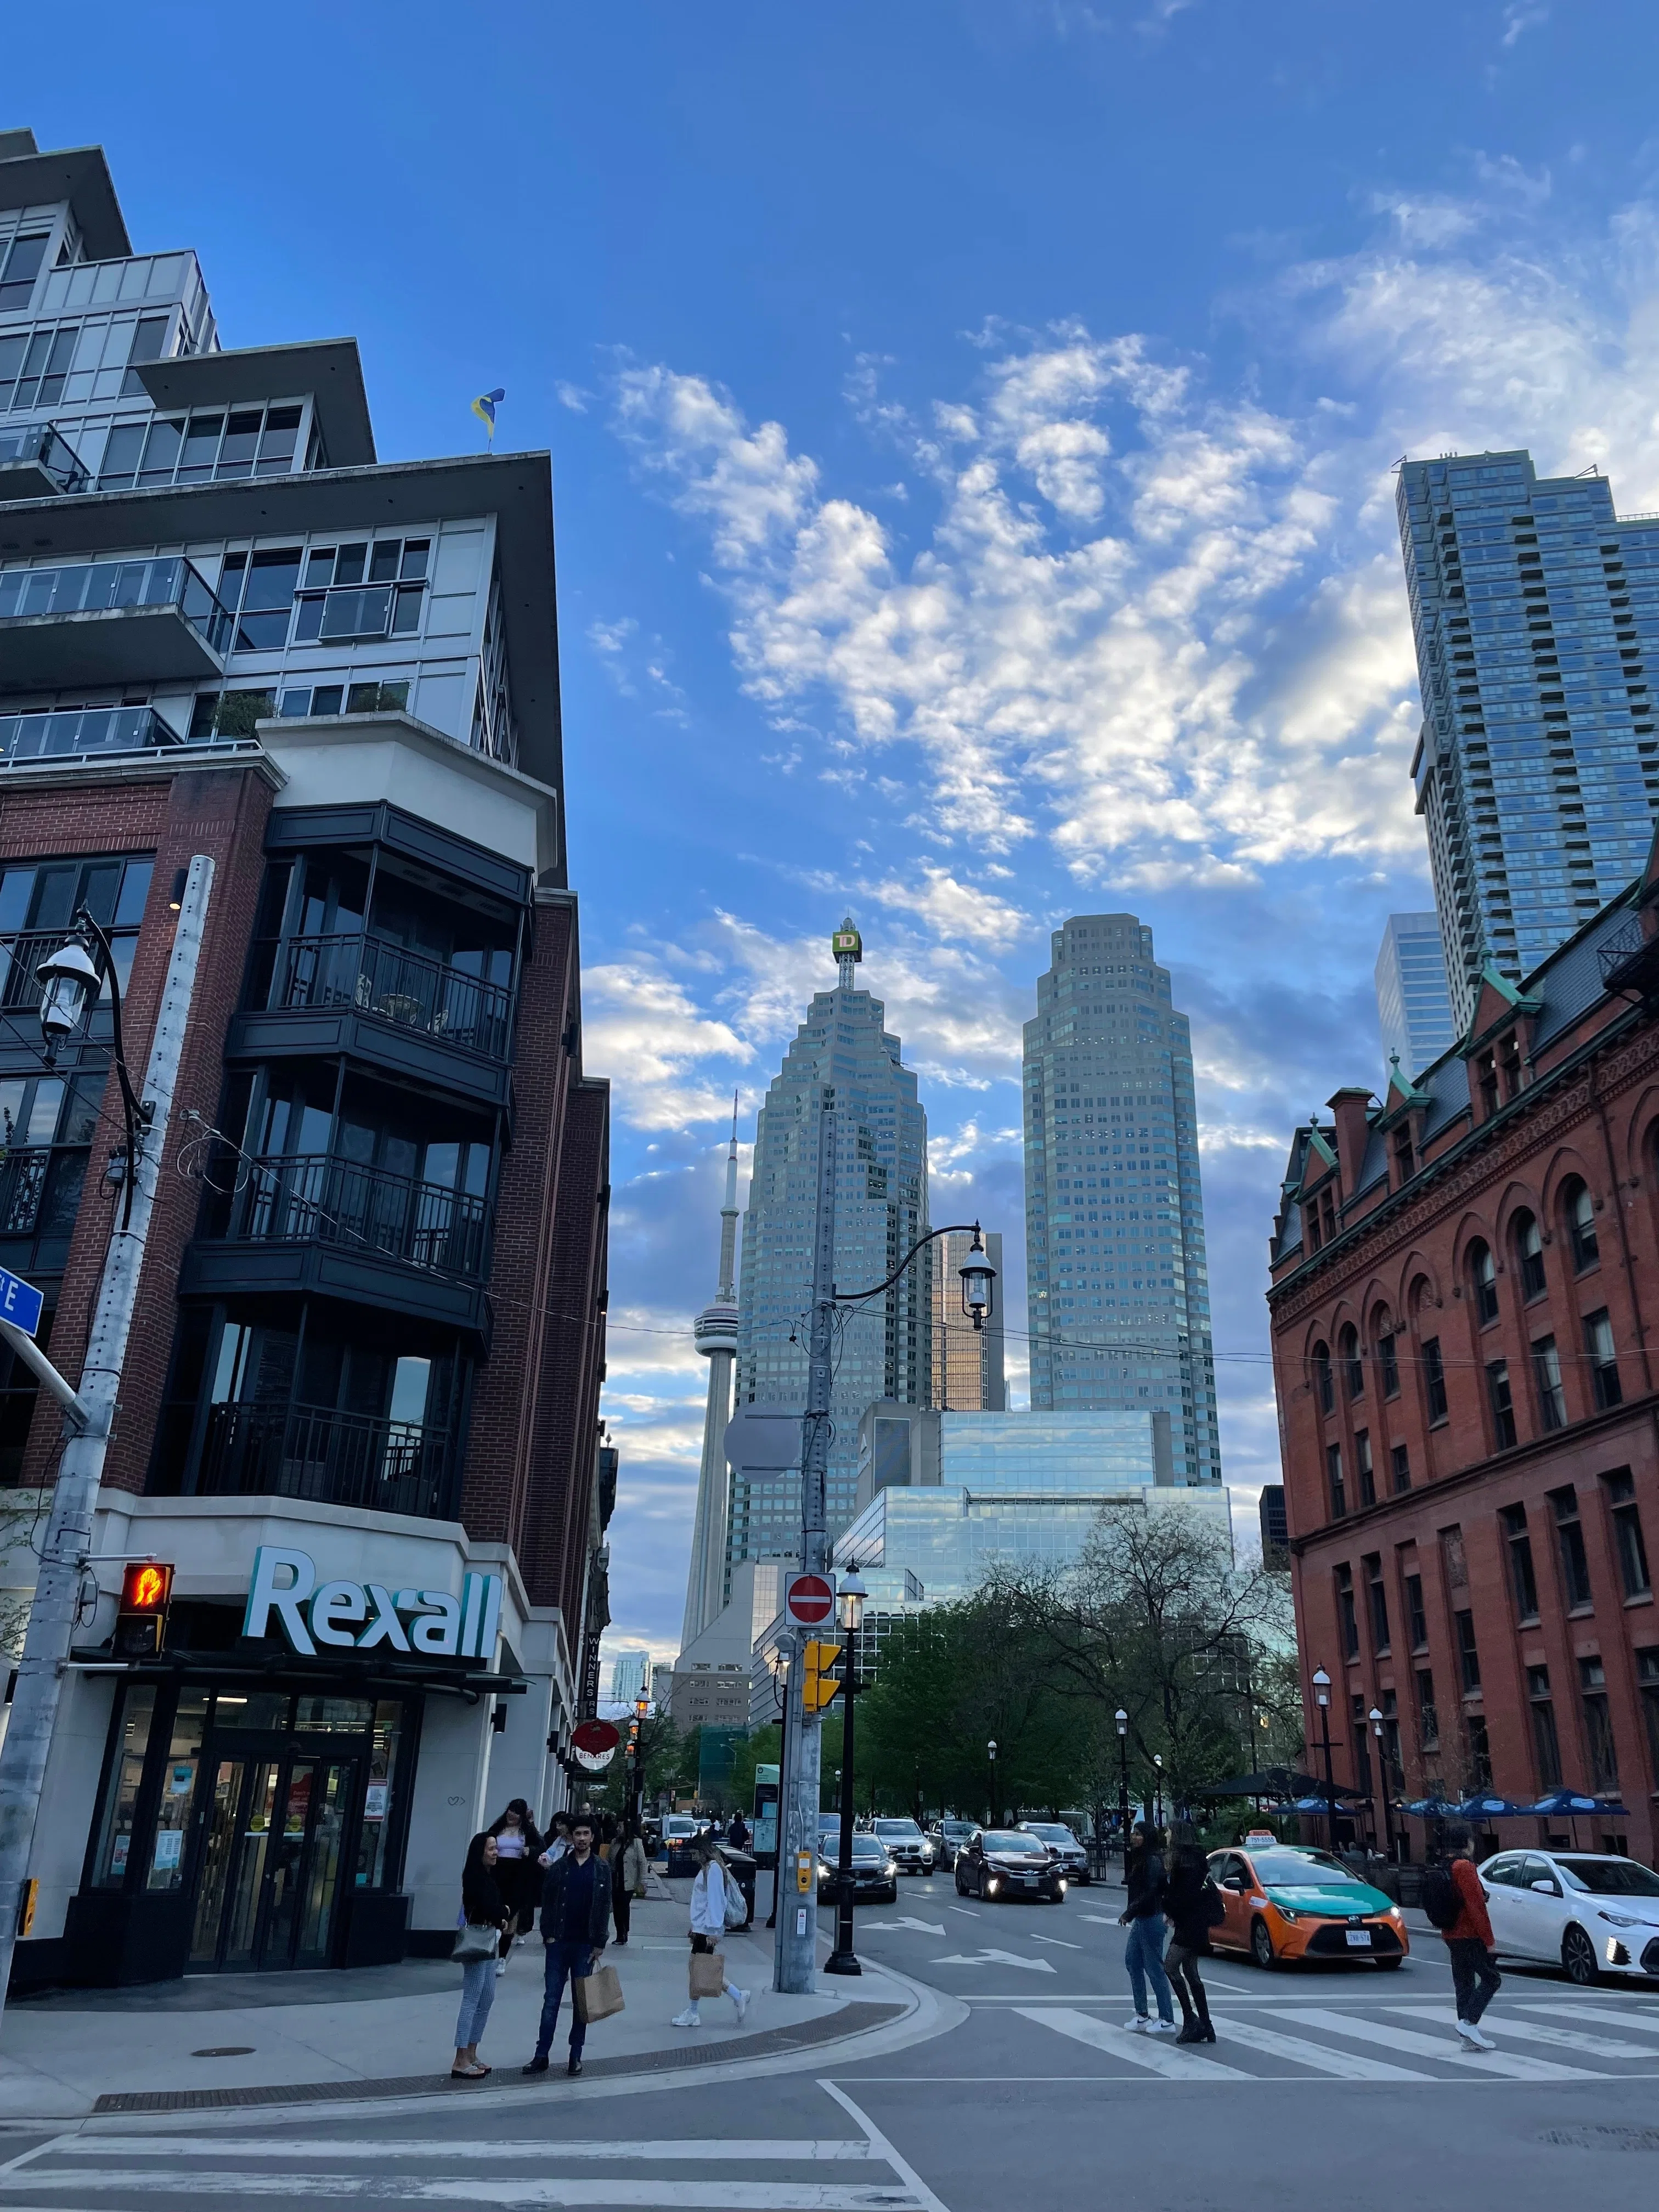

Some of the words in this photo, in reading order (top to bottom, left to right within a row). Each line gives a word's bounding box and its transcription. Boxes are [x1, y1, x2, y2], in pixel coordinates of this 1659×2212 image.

[835, 934, 855, 947] TD
[4, 1280, 19, 1312] E
[241, 1545, 502, 1659] Rexall
[586, 1637, 599, 1696] WINNERS
